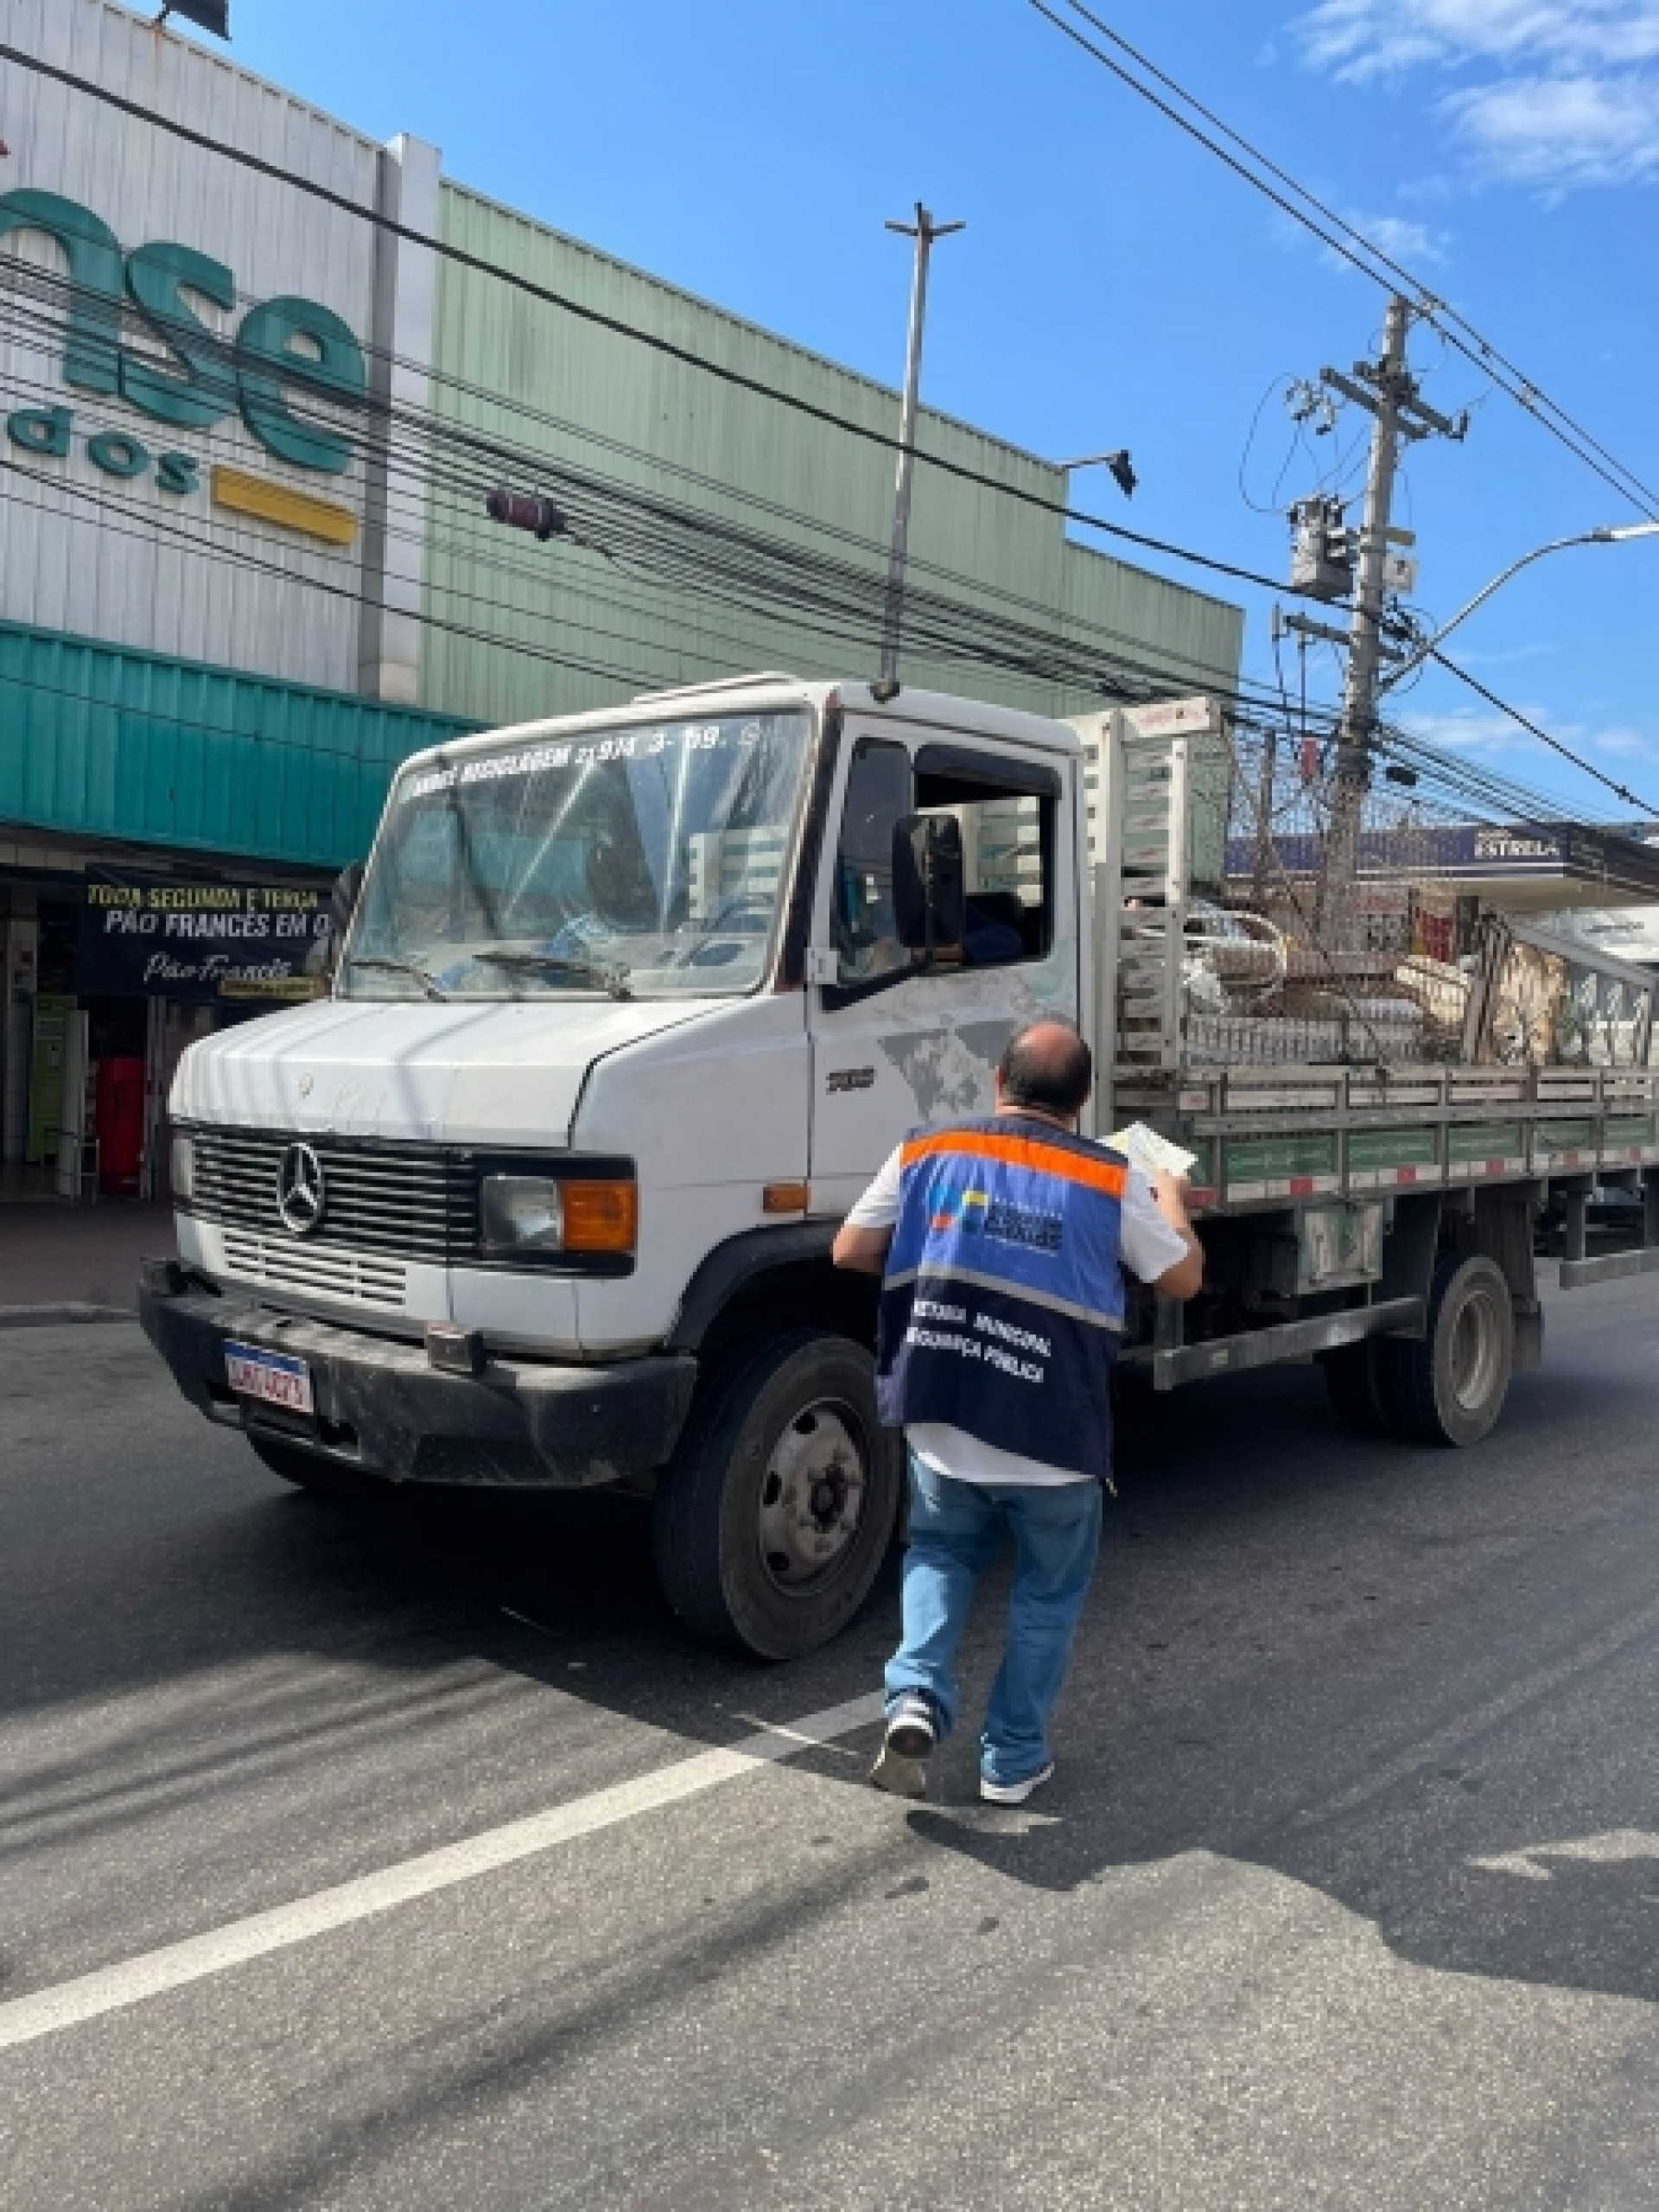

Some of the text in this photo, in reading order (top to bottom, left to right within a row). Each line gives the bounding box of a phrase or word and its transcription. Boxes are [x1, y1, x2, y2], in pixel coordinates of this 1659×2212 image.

[149, 888, 240, 908] SEGUNDA
[104, 909, 159, 934] PÃO
[165, 907, 270, 938] FRANCÊS
[276, 913, 308, 938] EM
